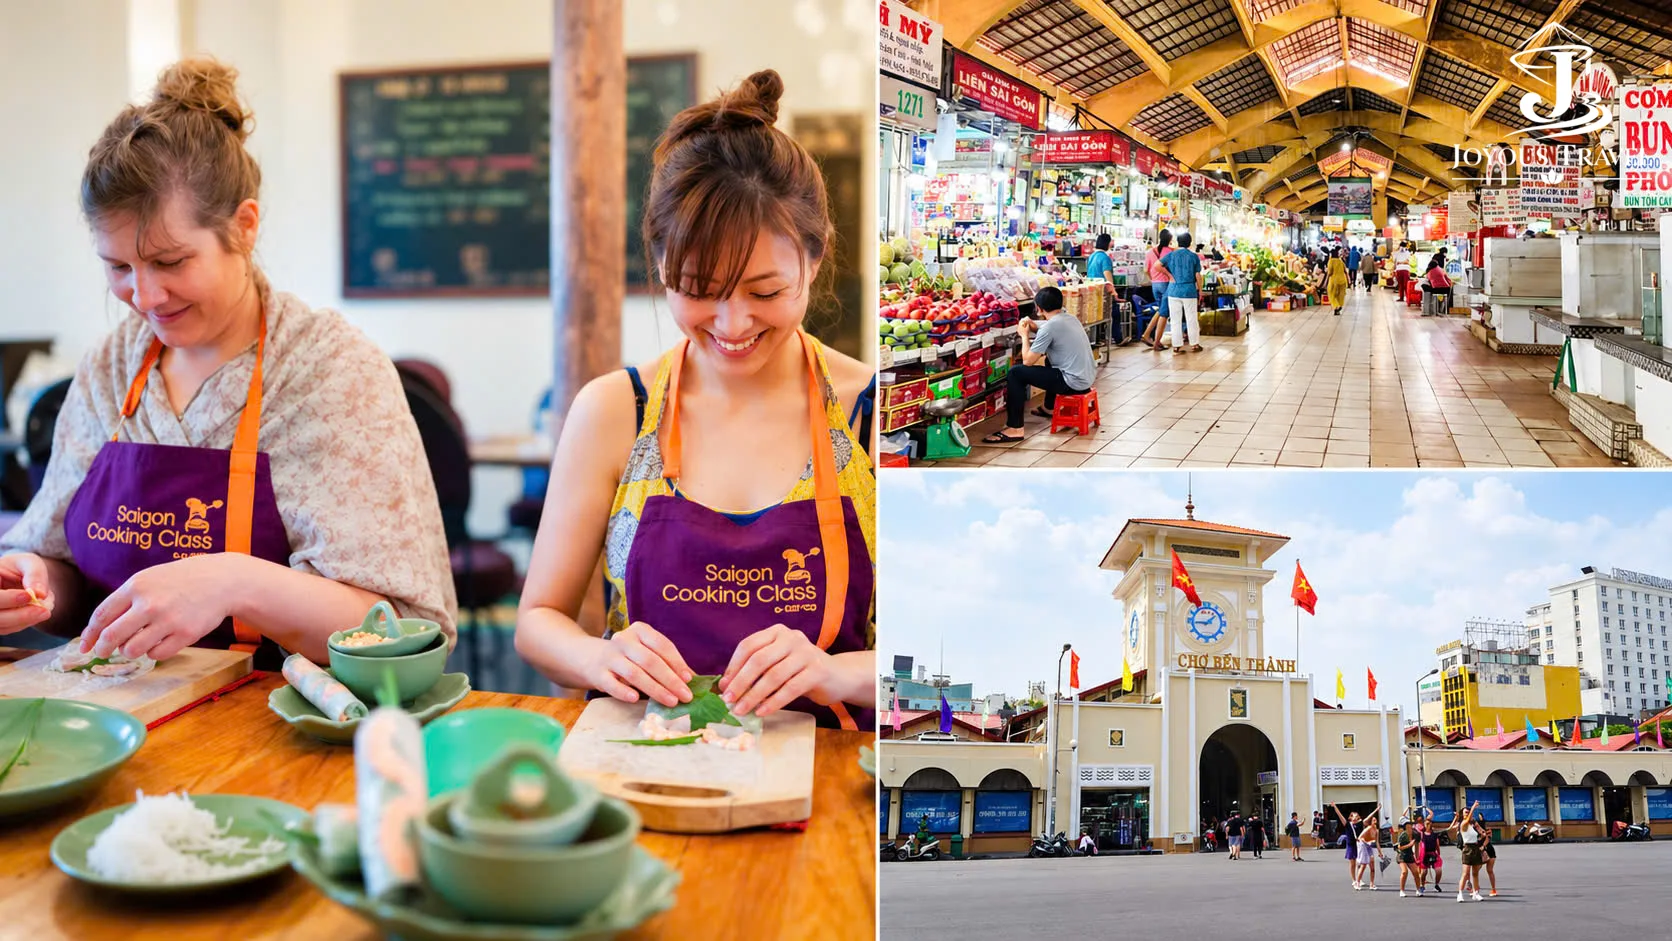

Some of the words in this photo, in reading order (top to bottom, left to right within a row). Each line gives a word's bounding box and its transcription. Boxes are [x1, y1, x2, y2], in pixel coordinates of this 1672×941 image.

[959, 70, 987, 93] LIÊN
[897, 89, 923, 118] 1271
[1625, 86, 1672, 109] CƠM
[1625, 110, 1672, 156] BÚN
[117, 504, 175, 528] Saigon
[87, 522, 152, 549] Cooking
[158, 530, 212, 549] Class
[705, 564, 773, 586] Saigon
[662, 584, 750, 608] Cooking
[756, 585, 817, 603] Class
[1213, 653, 1241, 670] BẾN
